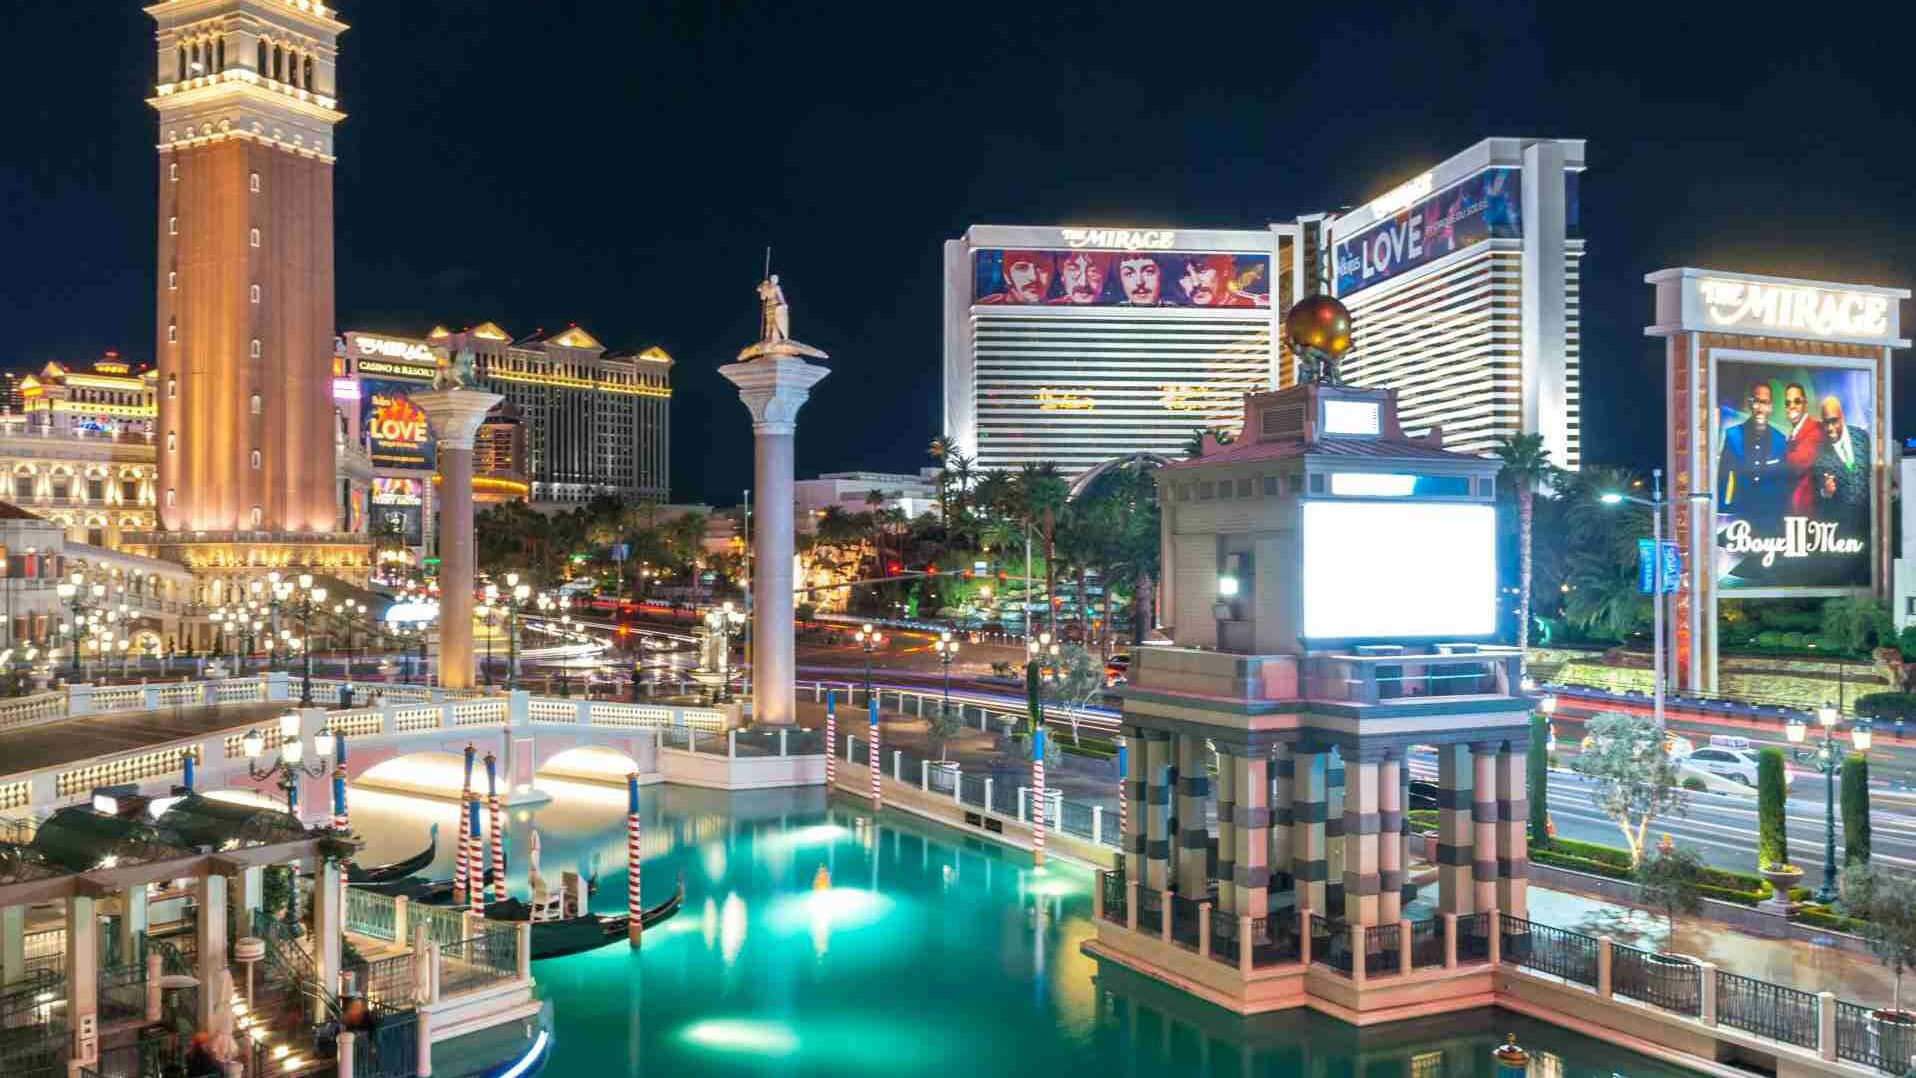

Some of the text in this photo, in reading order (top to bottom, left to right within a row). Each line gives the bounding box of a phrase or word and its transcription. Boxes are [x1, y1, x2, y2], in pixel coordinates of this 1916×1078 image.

[1069, 230, 1175, 250] MIRAGE
[1362, 214, 1424, 279] LOVE
[1710, 285, 1888, 335] MIRAGE
[359, 361, 393, 373] CASINO
[370, 417, 428, 441] LOVE
[1726, 516, 1865, 567] Boyz II Men
